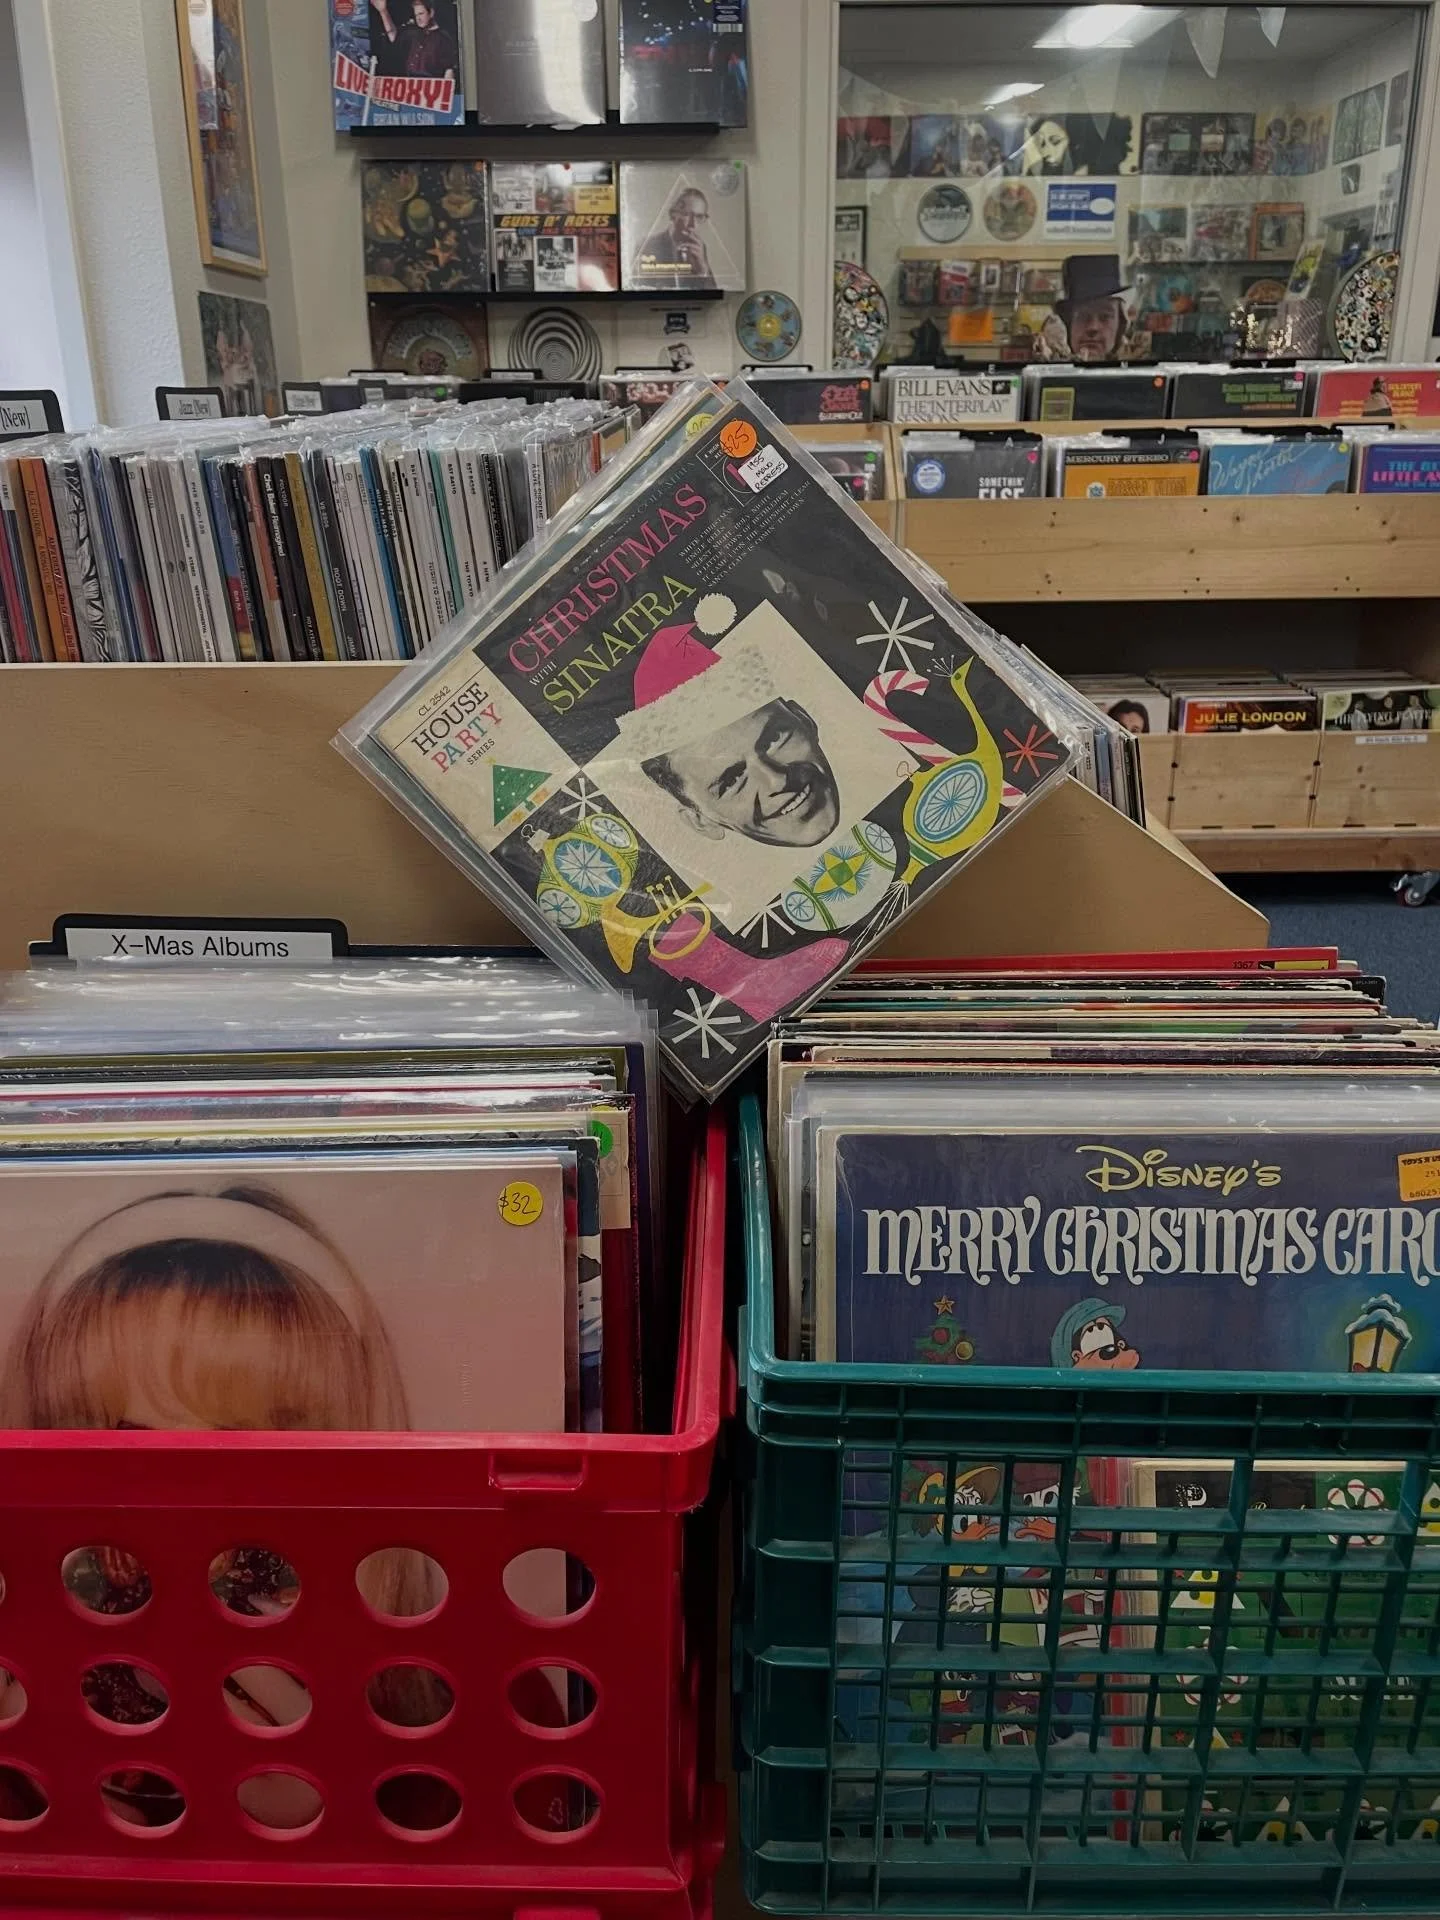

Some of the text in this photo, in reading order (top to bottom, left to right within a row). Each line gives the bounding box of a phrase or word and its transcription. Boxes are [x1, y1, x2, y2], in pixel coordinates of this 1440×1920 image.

[335, 54, 453, 111] LIVE ROXY!
[501, 215, 540, 227] GUNS
[564, 215, 610, 227] ROSES
[899, 379, 992, 397] BILL EVANS
[929, 399, 1005, 413] INTERPLAY
[720, 420, 750, 457] $25
[1004, 437, 1013, 448] A
[1158, 434, 1166, 445] J
[746, 455, 765, 471] 1955
[1066, 453, 1169, 464] MERCURY STEREO
[755, 462, 785, 490] REPRESS
[978, 477, 1024, 487] SOMETHIN'
[264, 473, 286, 557] Chet Baker Reimagined
[333, 567, 343, 588] ROOT
[509, 484, 707, 673] CHRISTMAS
[337, 590, 347, 612] DOWN
[347, 636, 357, 658] JIMMY
[543, 572, 695, 715] SINATRA
[529, 661, 557, 686] WITH
[418, 685, 452, 717] CL 2542
[411, 682, 489, 756] HOUSE
[1194, 711, 1307, 725] JULIE LONDON
[431, 703, 502, 774] PARTY
[466, 738, 495, 766] SERIES
[111, 934, 290, 957] X-Mas Albums
[1232, 961, 1254, 970] 1367
[498, 1191, 538, 1218] $32
[861, 1196, 1042, 1286] MERRY
